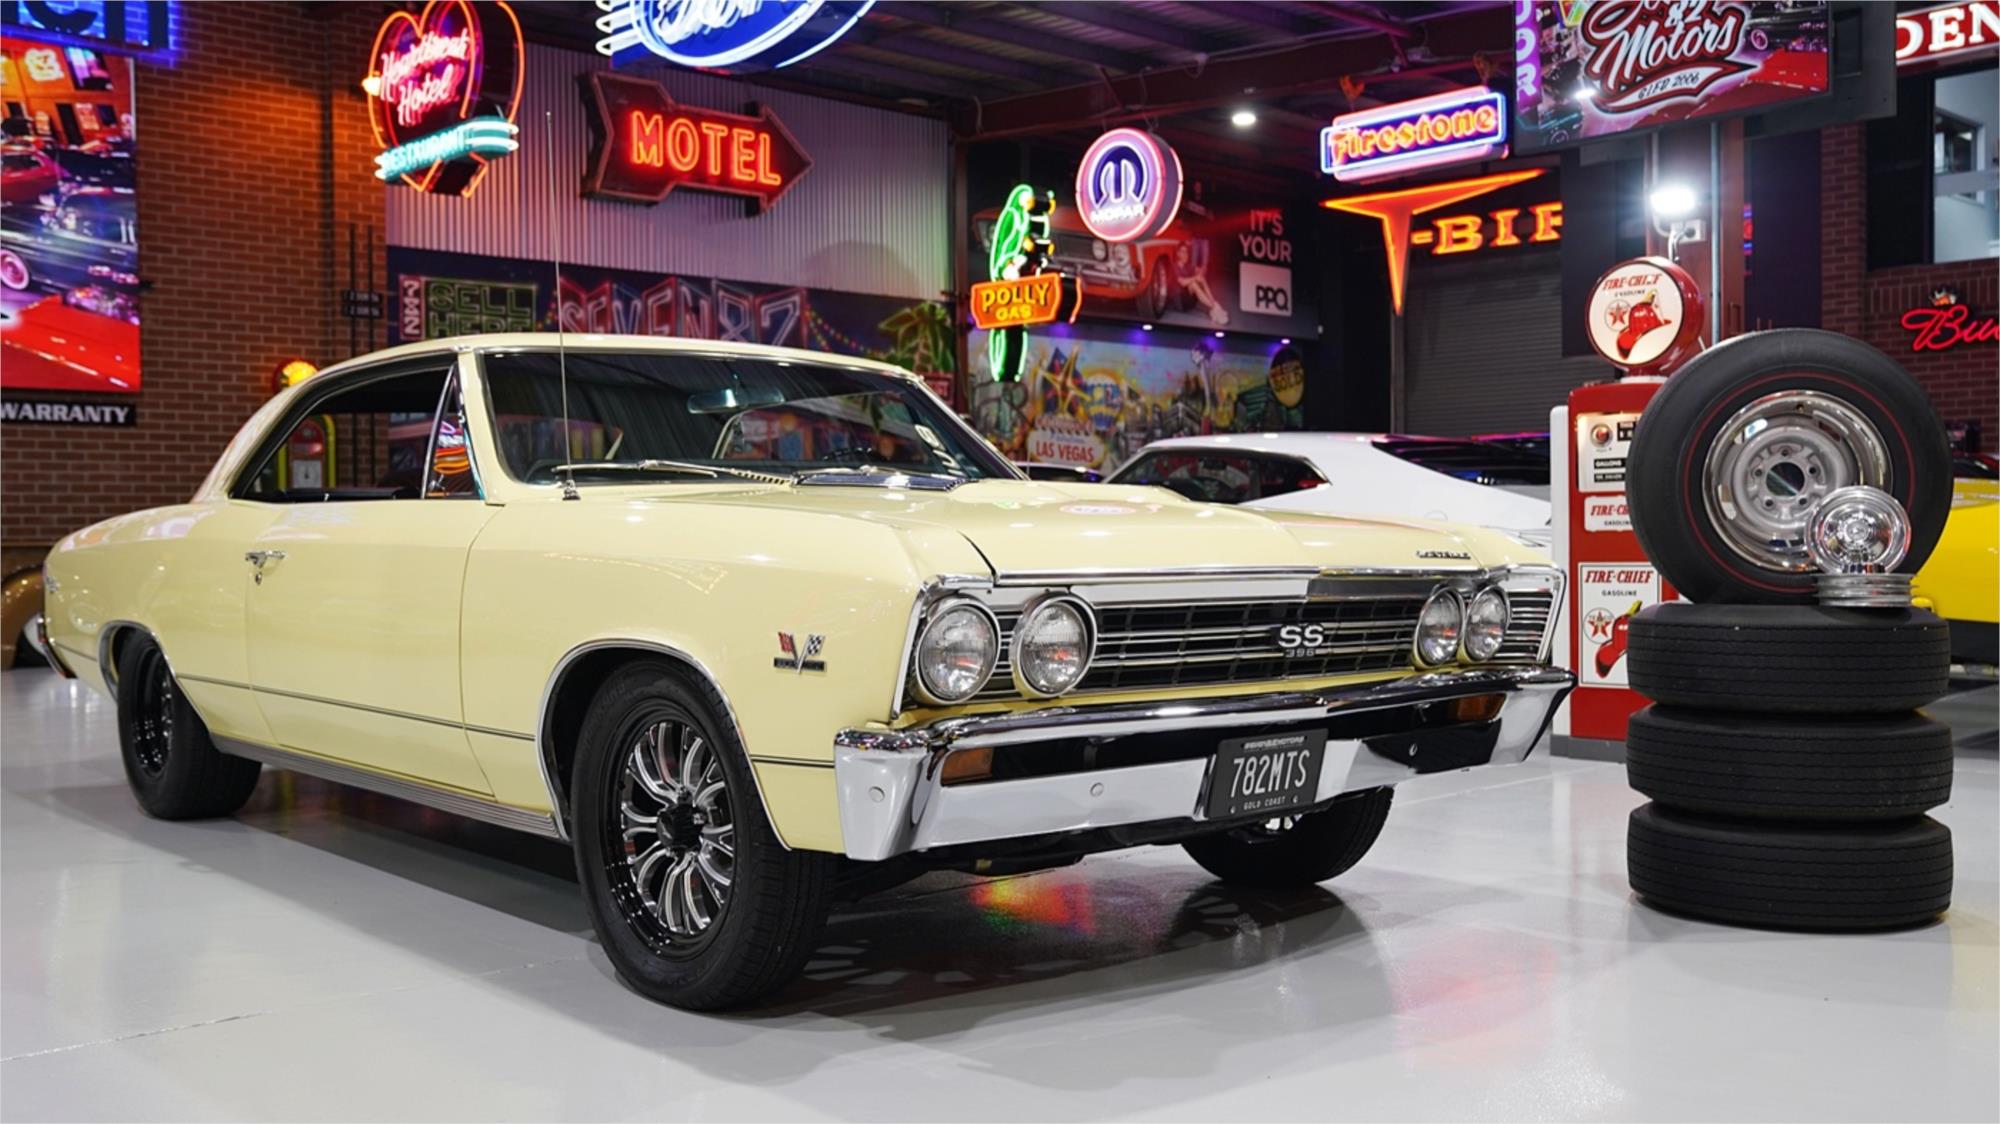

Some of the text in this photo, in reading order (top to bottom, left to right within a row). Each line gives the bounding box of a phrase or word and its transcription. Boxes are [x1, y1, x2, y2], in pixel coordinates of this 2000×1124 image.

[1592, 16, 1737, 90] Motors
[397, 64, 454, 125] Hotel
[632, 110, 782, 186] MOTEL
[1330, 104, 1498, 166] Firestone
[1091, 203, 1146, 224] MOPAR
[1250, 210, 1284, 236] IT'S
[1239, 233, 1292, 262] YOUR
[429, 282, 531, 317] SELL
[980, 283, 1050, 312] POLLY
[1256, 284, 1289, 311] PPQ
[995, 304, 1032, 320] GAS
[1901, 304, 1999, 351] Bu
[1, 402, 128, 423] WARRANTY
[1036, 441, 1094, 462] LAS VEGAS
[1584, 570, 1654, 583] FIRE-CHIEF
[1278, 625, 1323, 648] SS
[1285, 648, 1314, 658] 396
[1231, 749, 1310, 798] 782MTS
[1243, 796, 1286, 810] GOLD COAST
